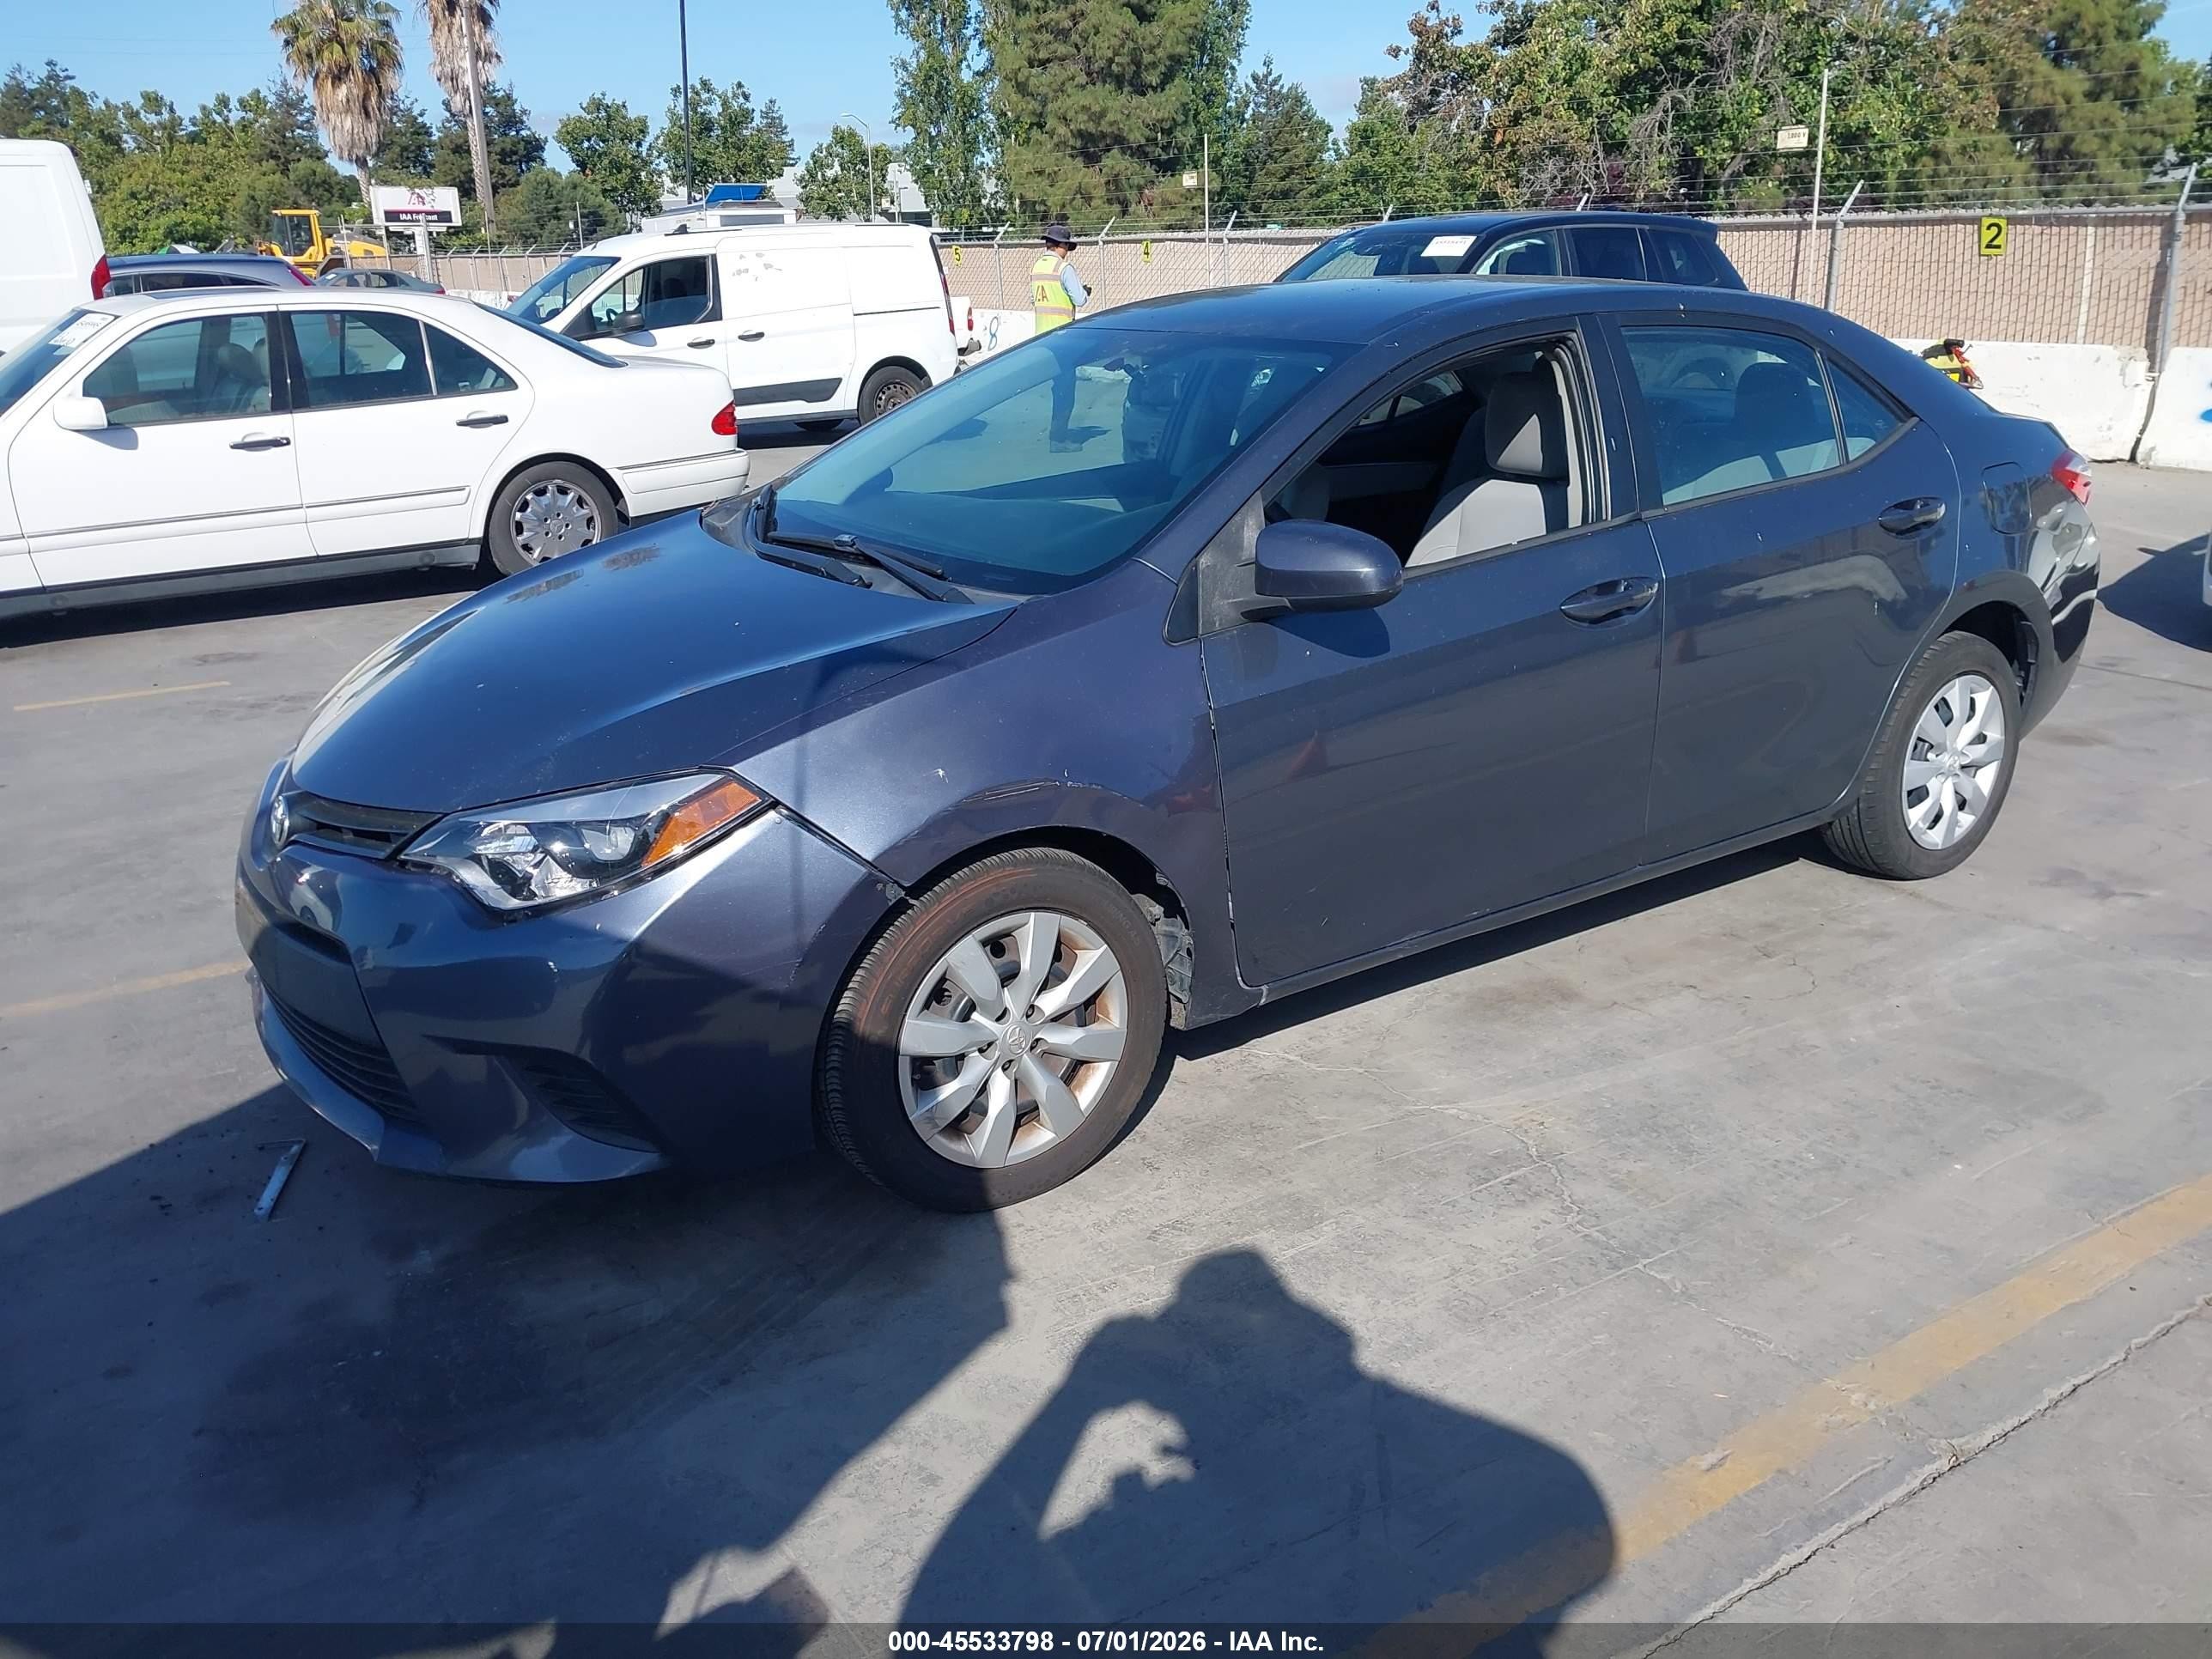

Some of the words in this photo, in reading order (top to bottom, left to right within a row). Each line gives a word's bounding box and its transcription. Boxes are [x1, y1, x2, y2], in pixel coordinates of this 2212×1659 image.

[399, 212, 412, 221] IAA
[1984, 222, 2002, 249] 2
[954, 247, 961, 262] 5
[1144, 241, 1150, 259] 4
